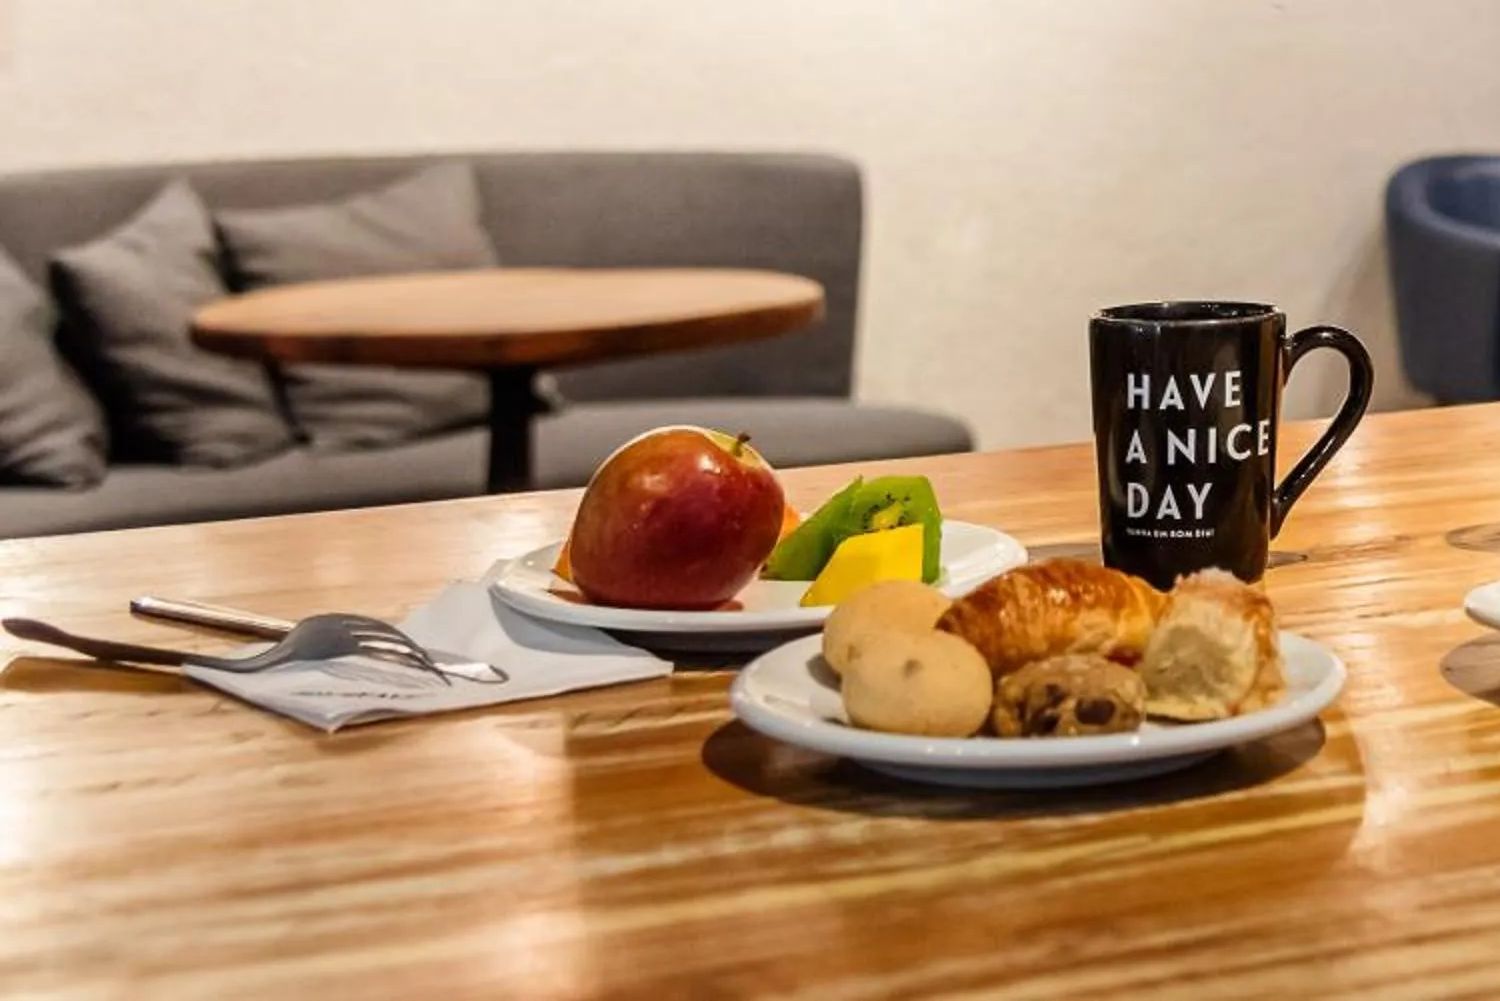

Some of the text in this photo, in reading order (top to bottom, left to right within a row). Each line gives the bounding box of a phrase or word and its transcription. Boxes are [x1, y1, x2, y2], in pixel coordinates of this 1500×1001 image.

[1126, 371, 1241, 411] HAVE
[1125, 419, 1270, 465] A NICE
[1127, 483, 1213, 520] DAY
